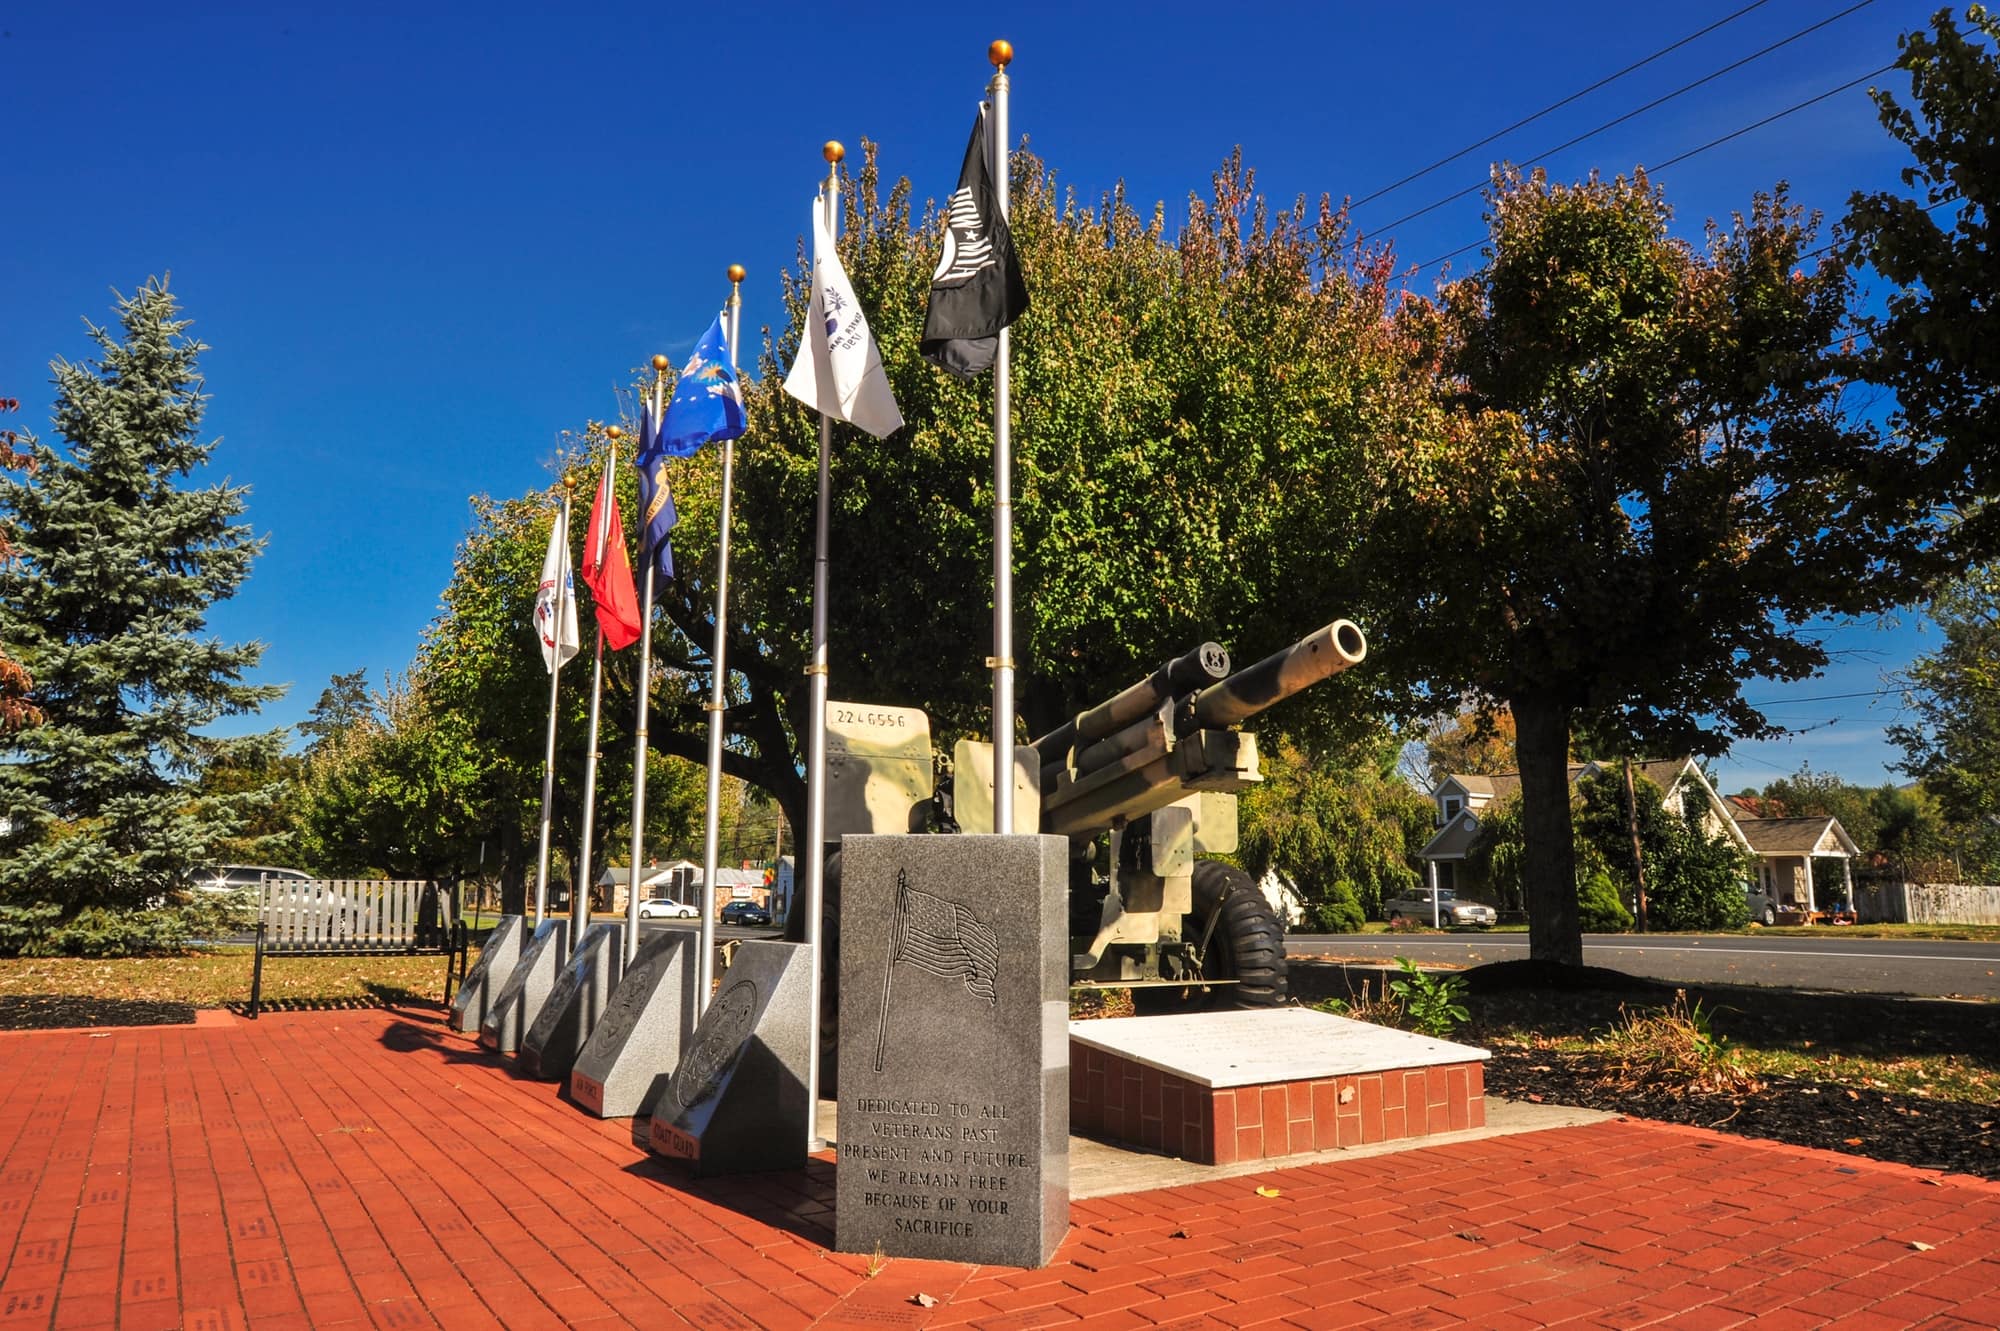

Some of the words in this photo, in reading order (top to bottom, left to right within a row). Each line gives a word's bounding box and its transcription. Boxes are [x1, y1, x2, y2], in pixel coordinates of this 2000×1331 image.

[856, 1098, 940, 1117] DEDICATED
[951, 1103, 970, 1118] TO
[979, 1105, 1009, 1119] ALL
[871, 1122, 952, 1140] VETERANS
[843, 1144, 909, 1161] PRESENT
[919, 1150, 953, 1164] AND
[866, 1169, 889, 1184] WE
[899, 1171, 959, 1188] REMAIN
[969, 1175, 1008, 1191] FREE
[864, 1192, 930, 1210] BECAUSE
[938, 1197, 957, 1211] OF
[968, 1199, 1009, 1215] YOUR
